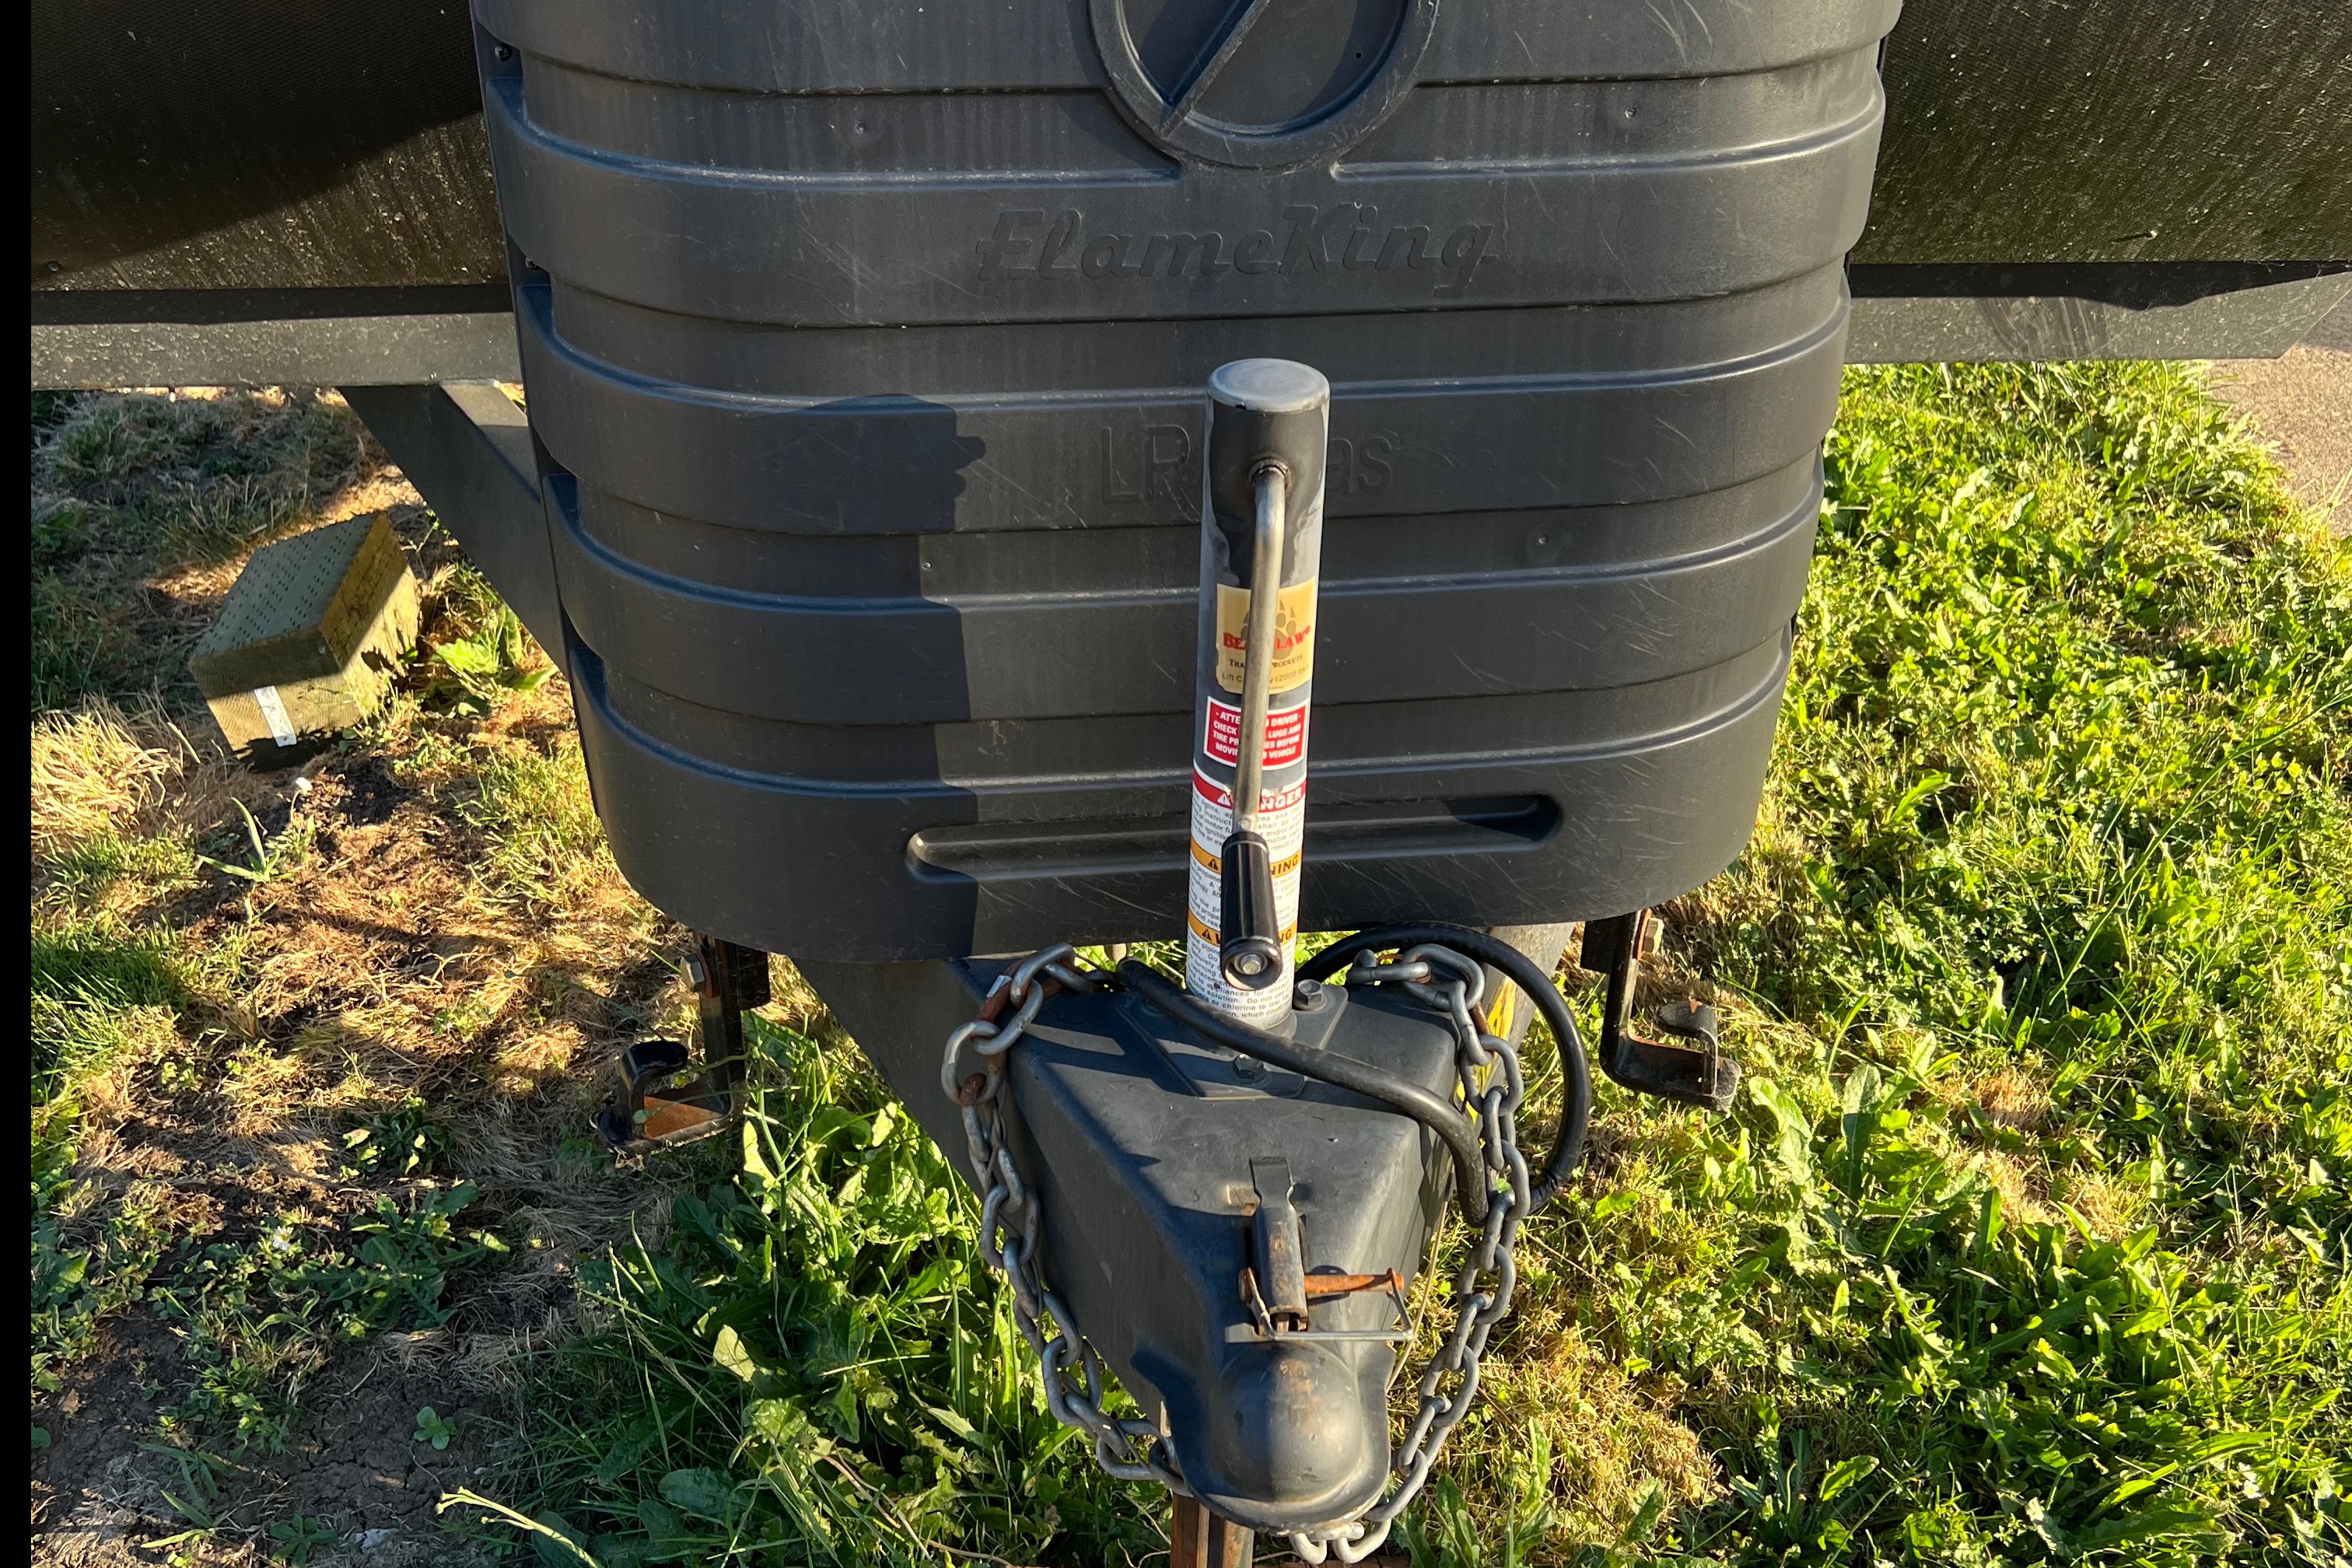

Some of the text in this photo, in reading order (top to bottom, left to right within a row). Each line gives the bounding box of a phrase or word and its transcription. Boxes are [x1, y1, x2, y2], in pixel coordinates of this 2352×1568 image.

[975, 205, 1498, 297] FlameKing
[1272, 654, 1303, 669] RODUCTS
[1271, 713, 1298, 726] DRIVER
[1213, 720, 1301, 739] CHECK LUGS AND
[1213, 730, 1227, 744] TIRE
[1276, 734, 1300, 748] BEFORE
[1269, 745, 1296, 759] VEHICLE
[1259, 786, 1302, 810] NGER
[1222, 1003, 1256, 1011] chlorine
